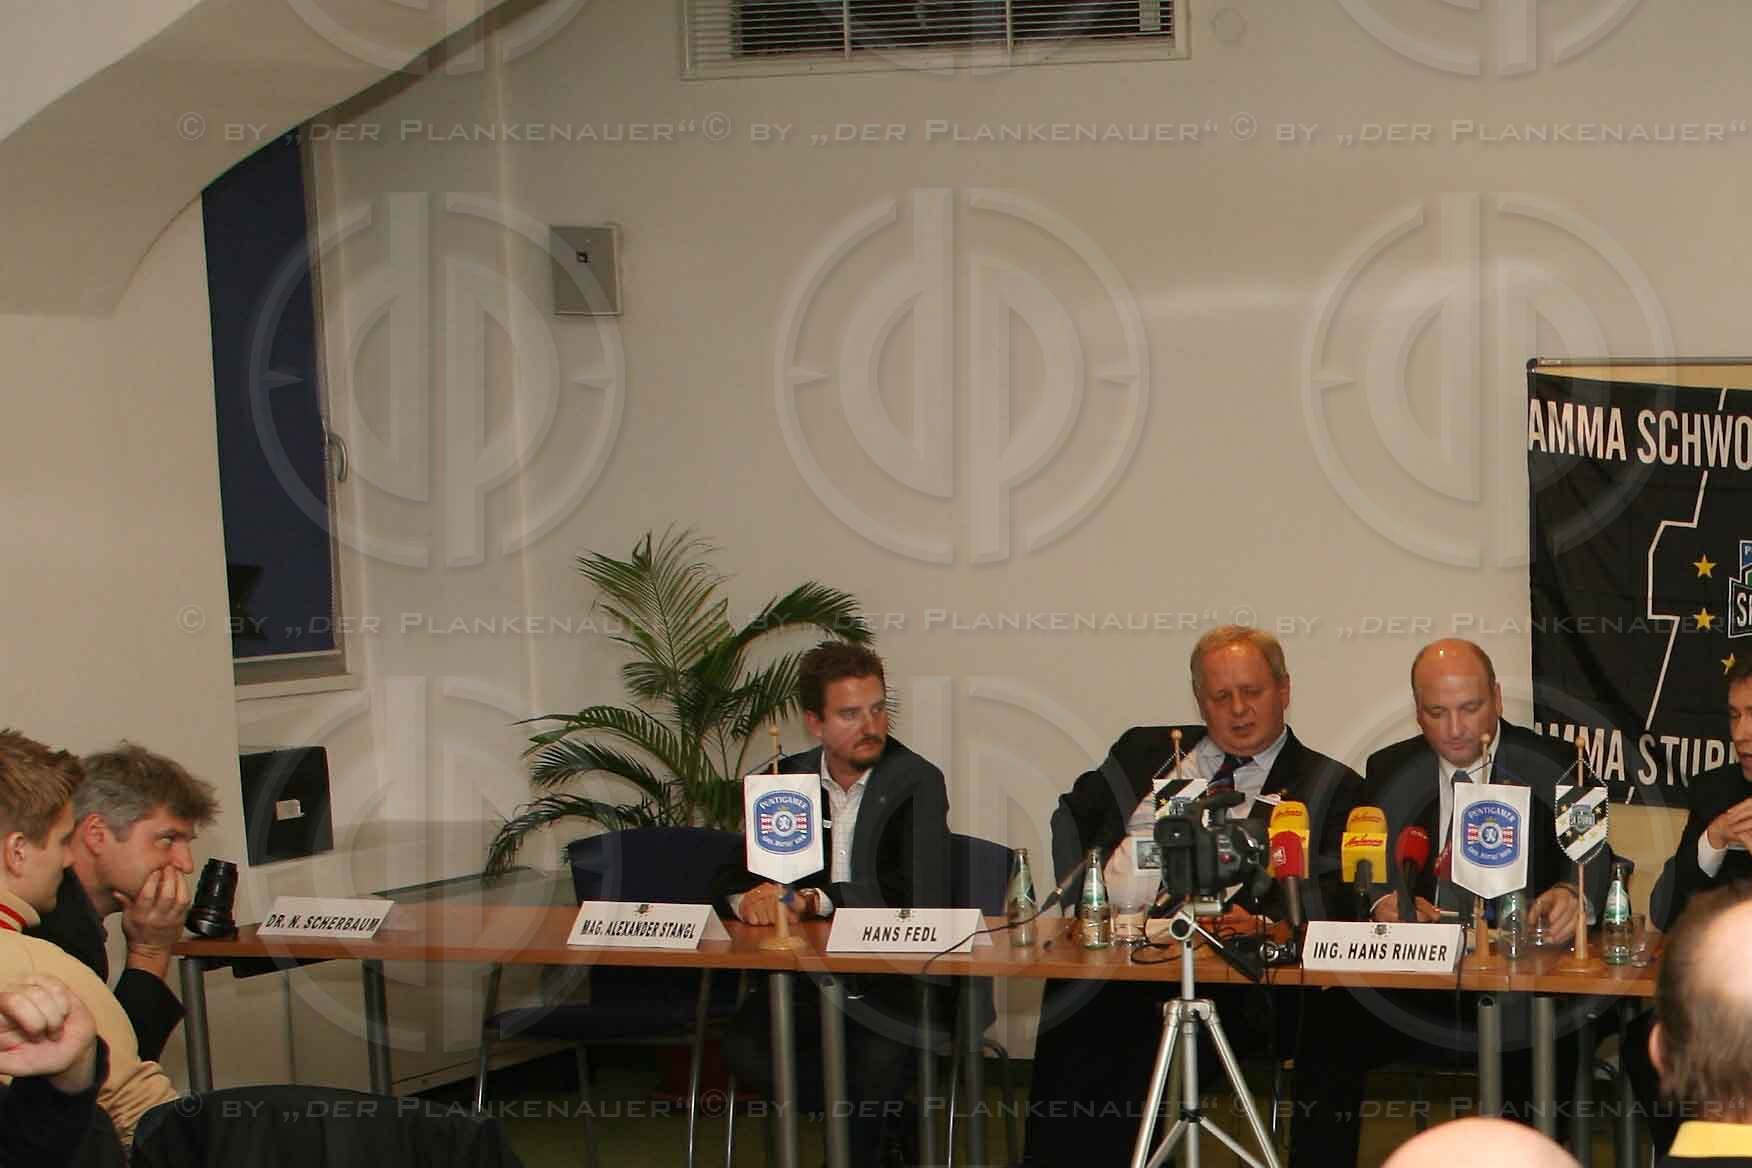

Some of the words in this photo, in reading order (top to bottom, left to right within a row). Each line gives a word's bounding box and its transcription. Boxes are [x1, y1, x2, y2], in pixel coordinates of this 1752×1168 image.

[1528, 398, 1626, 461] AMMA
[1535, 722, 1625, 782] MA
[1638, 733, 1739, 787] STUR
[266, 914, 285, 929] DR.
[304, 915, 380, 931] SCHERBAUM
[581, 919, 603, 936] MAG.
[606, 920, 659, 937] ALEXANDER
[660, 921, 696, 939] STANGL
[862, 926, 900, 942] HANS
[904, 926, 937, 942] FEDL
[1313, 942, 1342, 959] ING.
[1348, 943, 1387, 960] HANS
[1392, 944, 1447, 961] RINNER
